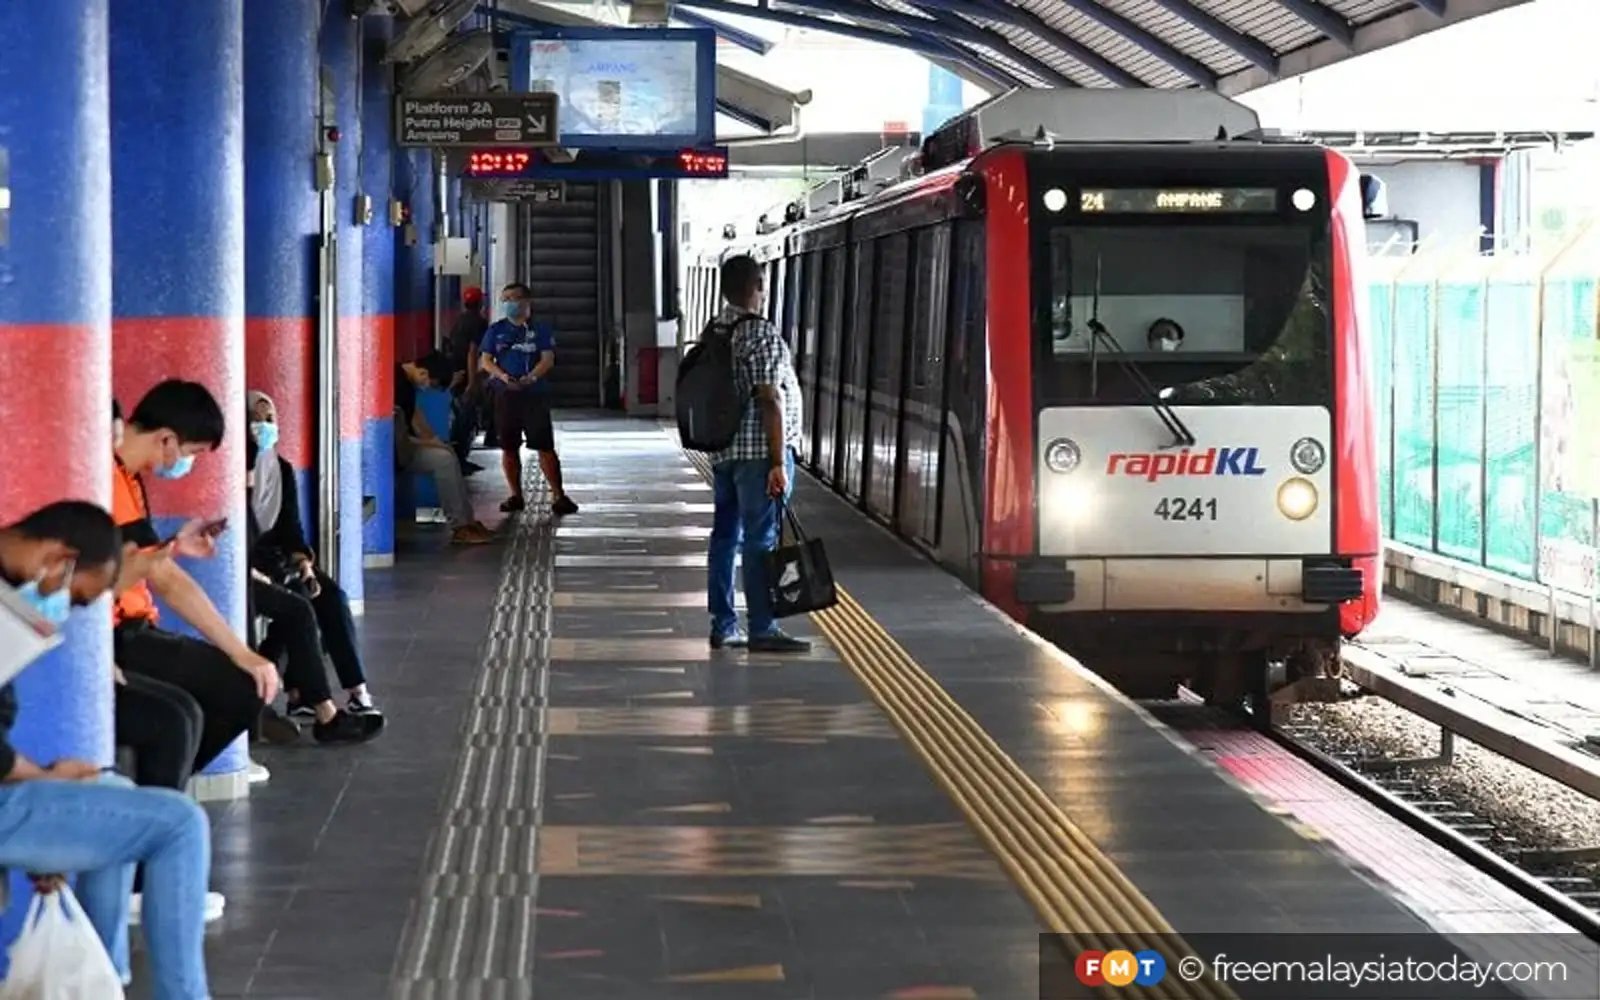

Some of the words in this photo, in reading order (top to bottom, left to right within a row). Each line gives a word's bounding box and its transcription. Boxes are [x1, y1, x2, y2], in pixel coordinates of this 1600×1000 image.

[405, 101, 468, 115] Platform
[471, 101, 493, 115] 2A
[405, 117, 441, 128] Putra
[443, 117, 492, 130] Heights
[406, 130, 460, 142] Ampang
[471, 153, 528, 171] 12:17
[1157, 193, 1223, 207] AMPANG
[1107, 448, 1266, 482] rapidKL
[1154, 498, 1218, 521] 4241
